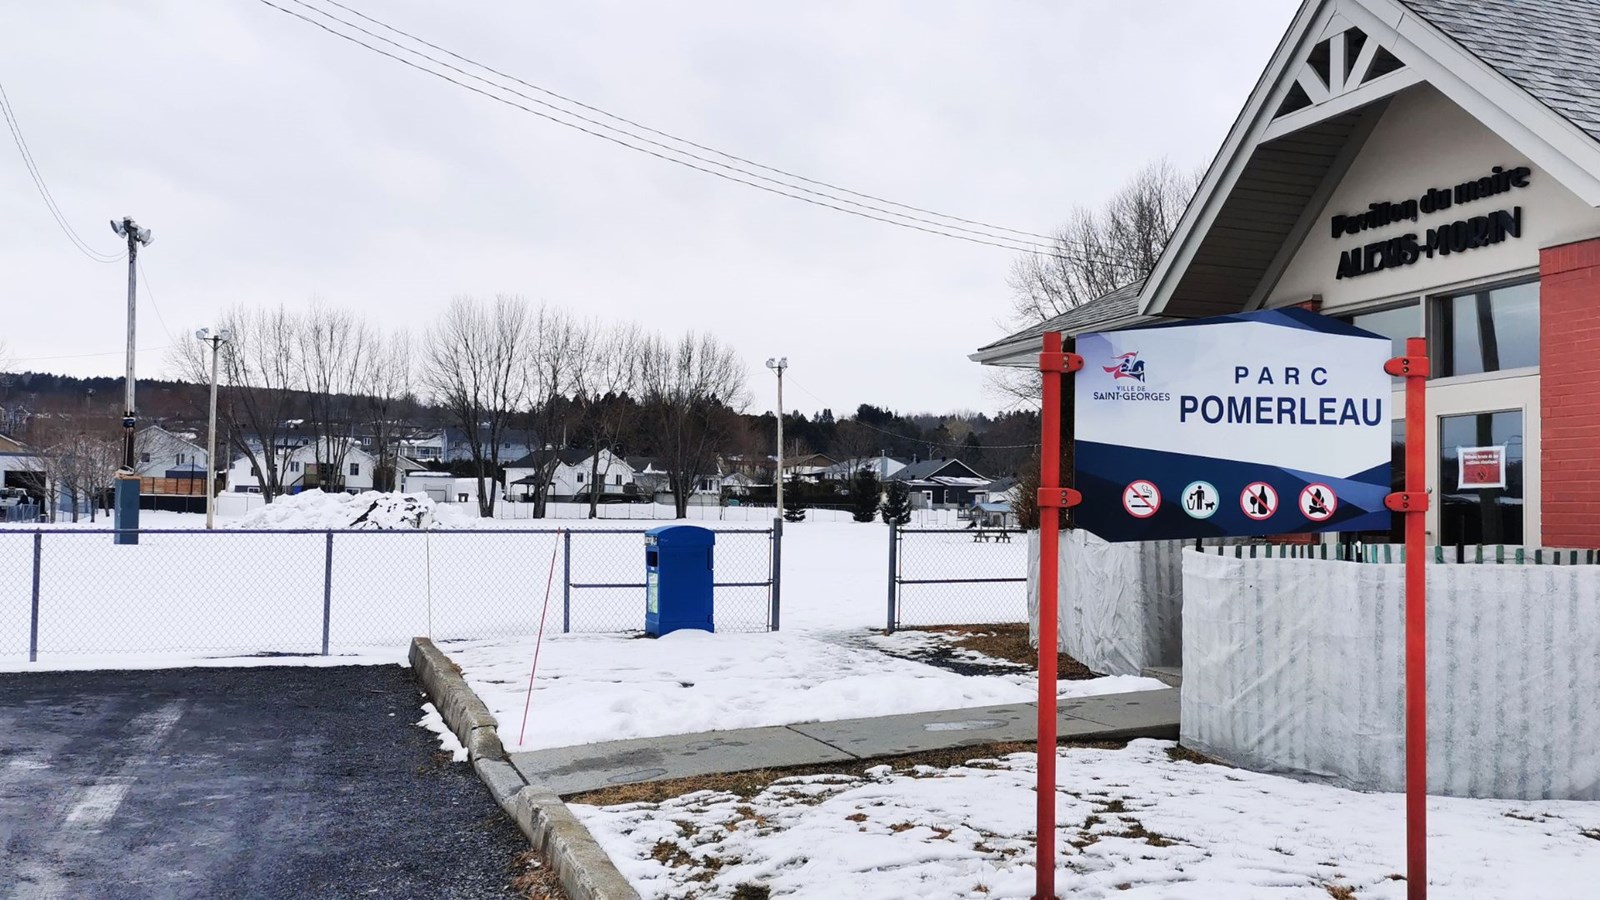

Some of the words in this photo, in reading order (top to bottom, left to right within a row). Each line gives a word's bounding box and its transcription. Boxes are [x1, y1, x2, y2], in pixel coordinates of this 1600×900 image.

[1331, 199, 1418, 238] Pavillon
[1419, 188, 1452, 214] du
[1454, 166, 1531, 204] maire
[1336, 206, 1521, 280] ALEXIS-MORIN
[1234, 366, 1328, 386] PARC
[1093, 391, 1171, 402] SAINT-GEORGES
[1180, 395, 1382, 426] POMERLEAU
